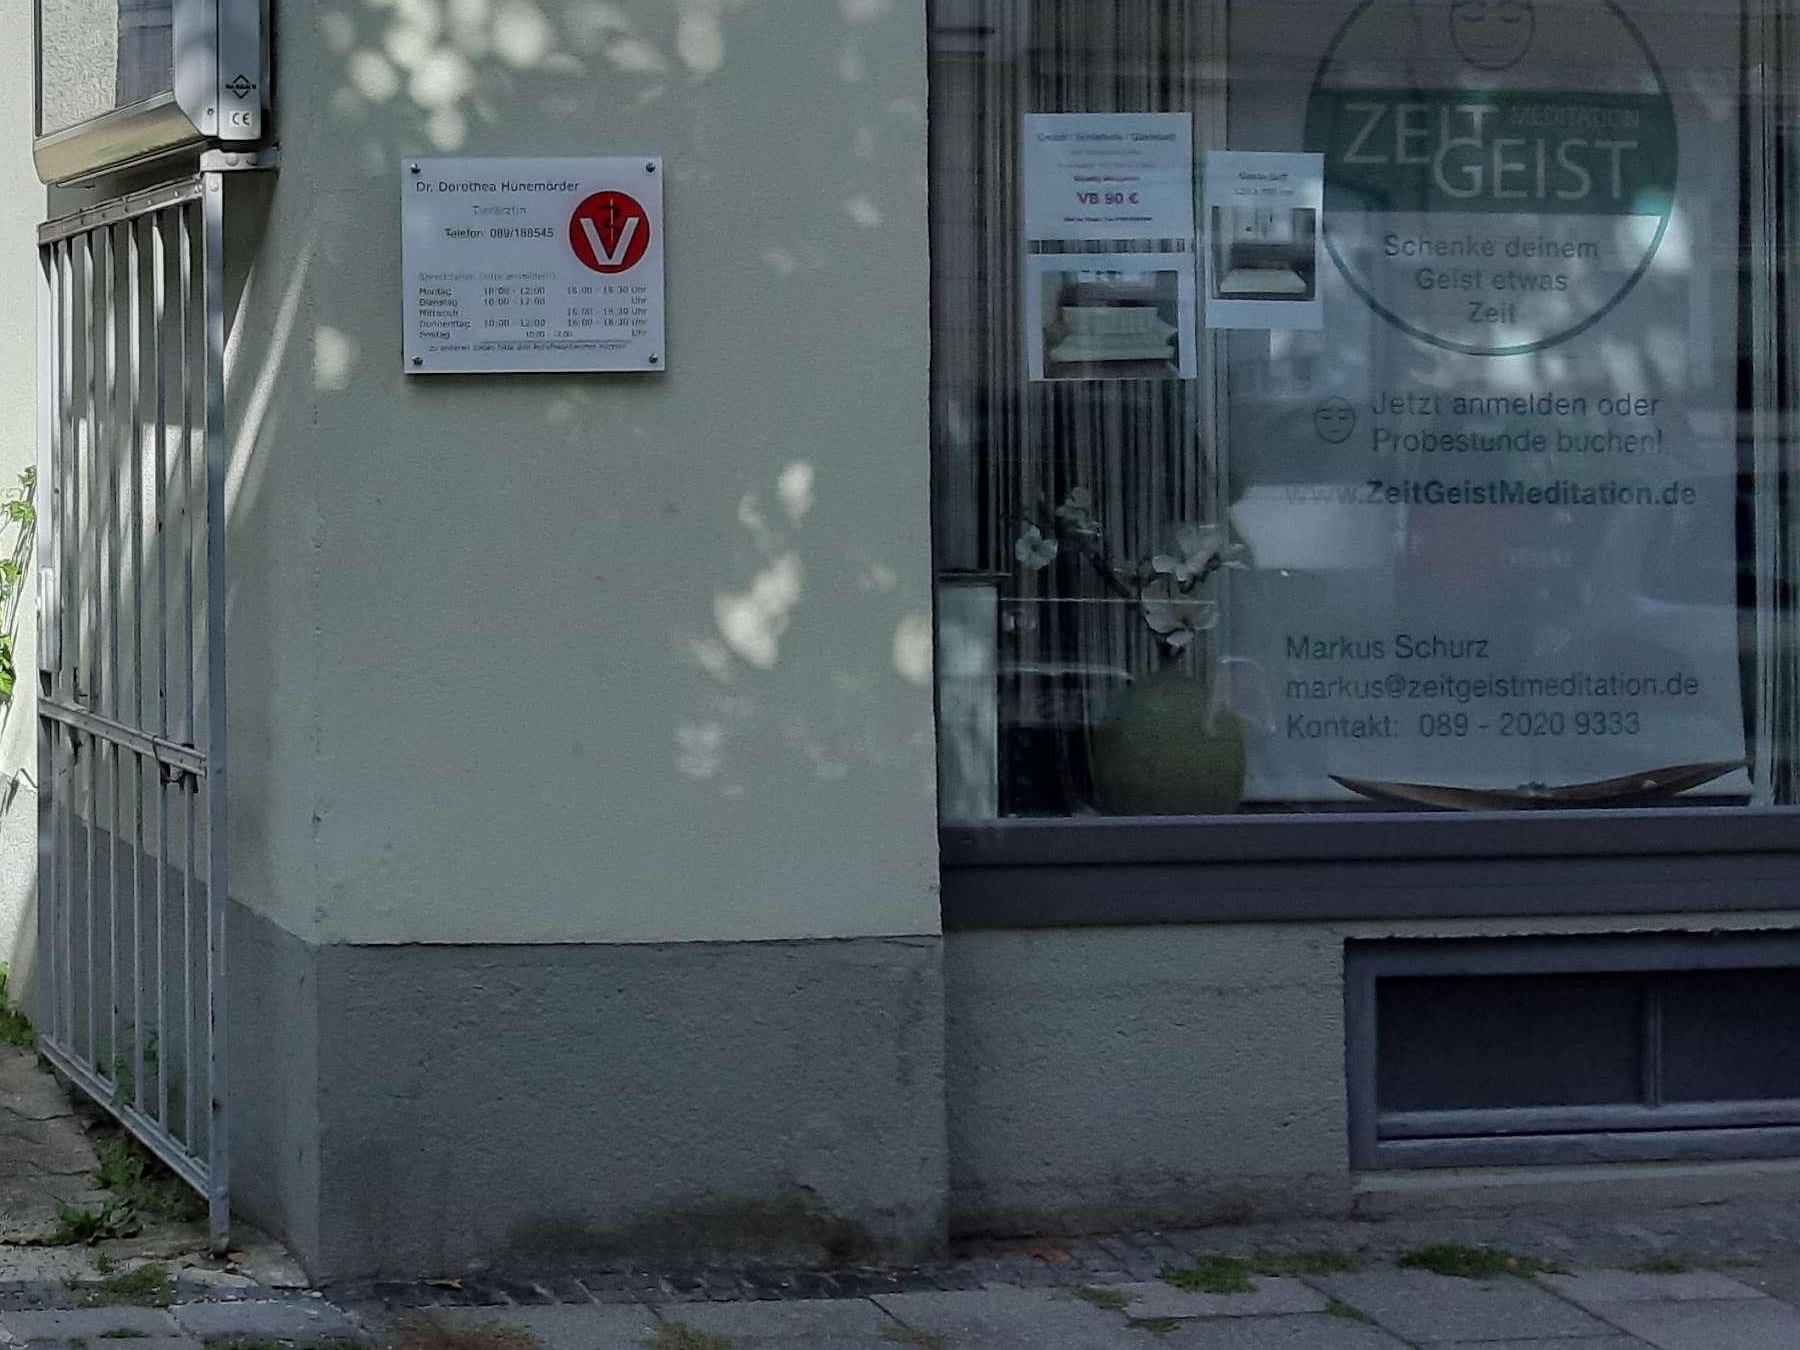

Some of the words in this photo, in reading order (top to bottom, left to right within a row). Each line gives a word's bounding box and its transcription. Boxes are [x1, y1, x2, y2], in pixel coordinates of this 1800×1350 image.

[1343, 102, 1498, 165] ZEIT
[1432, 138, 1640, 201] GEIST
[416, 181, 433, 193] Dr.
[439, 181, 497, 193] Dorothea
[1384, 233, 1495, 259] Schenke
[1504, 234, 1599, 259] deinem
[1415, 267, 1483, 292] Geist
[1492, 268, 1569, 292] etwas
[1469, 301, 1517, 324] Zeit
[1371, 393, 1442, 417] Jetzt
[1452, 393, 1587, 418] anmelden
[1598, 393, 1662, 418] oder
[1372, 428, 1546, 454] Probestunde
[1557, 428, 1663, 454] buchen!
[1286, 481, 1697, 507] www.ZeitGeistMeditation.de
[1286, 635, 1385, 660] Markus
[1395, 634, 1489, 660] Schurz
[1286, 673, 1699, 703] markus@zeitgeistmeditation.de
[1286, 713, 1399, 739] Kontakt:
[1420, 712, 1469, 738] 089
[1500, 712, 1565, 738] 2020
[1575, 711, 1641, 736] 9333
